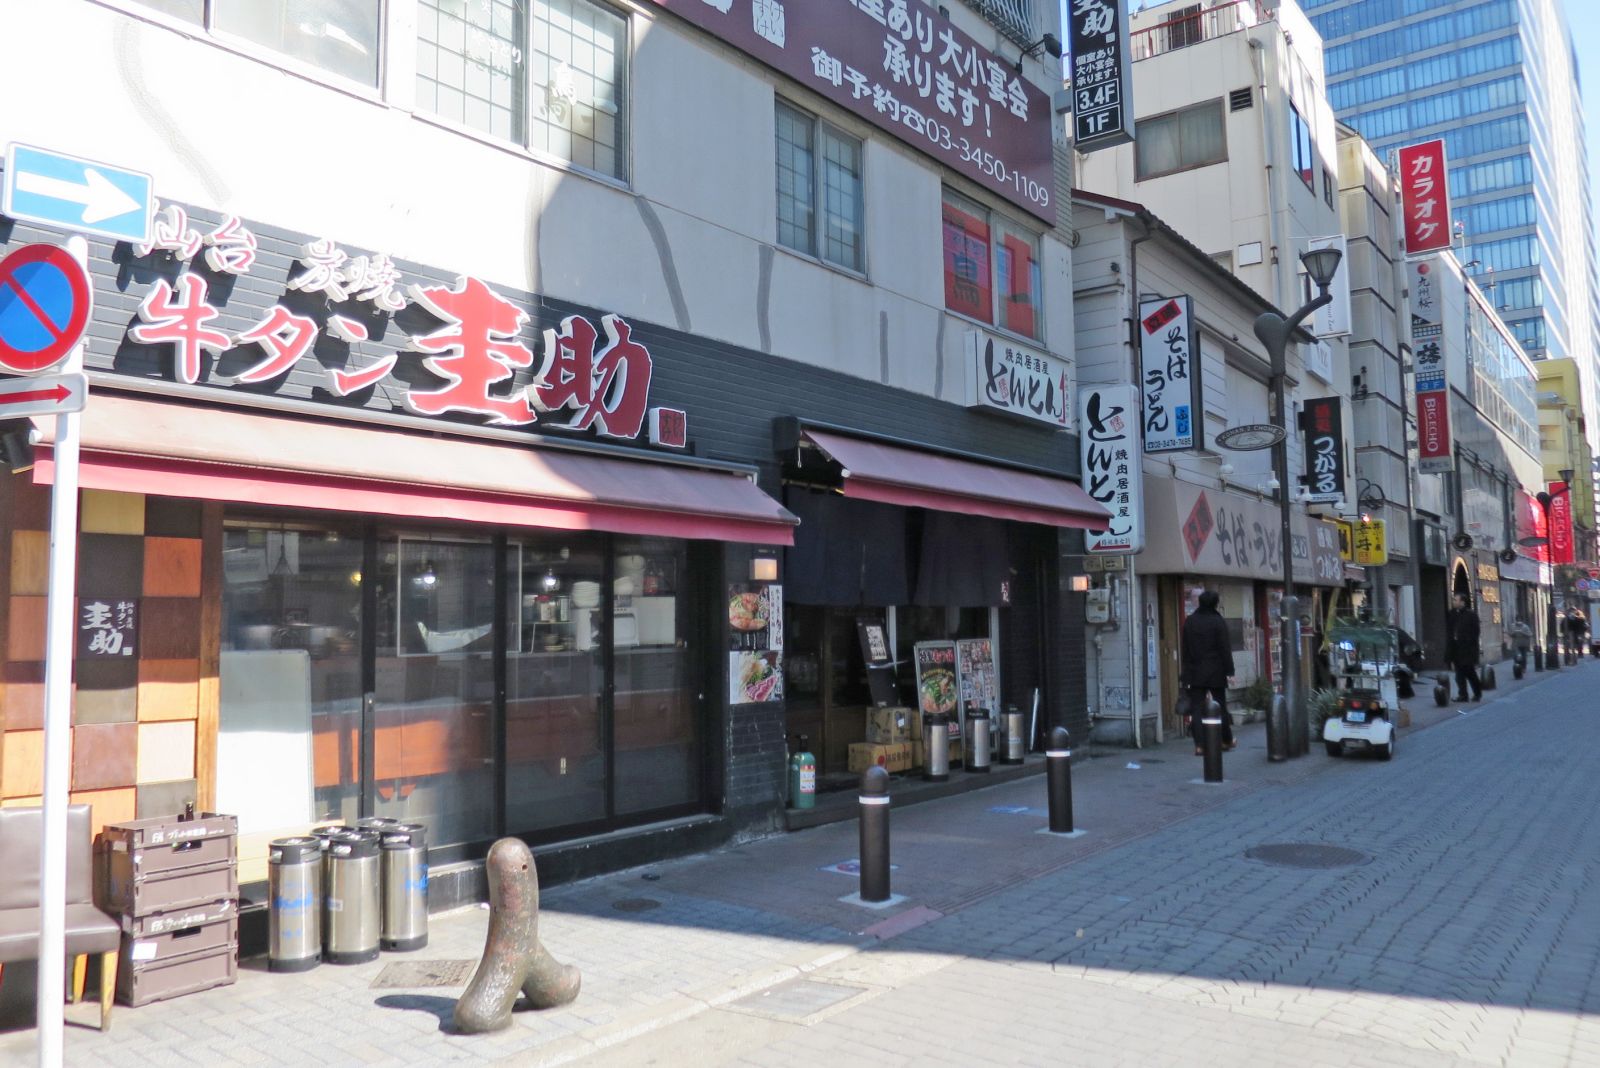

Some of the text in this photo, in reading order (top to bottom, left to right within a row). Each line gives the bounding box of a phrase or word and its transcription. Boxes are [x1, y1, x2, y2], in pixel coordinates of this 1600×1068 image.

[1076, 46, 1115, 67] 個室あり
[1077, 57, 1115, 77] 大小宴会
[1080, 83, 1116, 111] 3.4F
[1087, 112, 1110, 133] 1F
[811, 46, 1049, 207] 御予約 03-3450-1109
[1411, 156, 1439, 242] カラオケ
[138, 200, 258, 274] 仙台
[985, 337, 1063, 418] とんとん
[1005, 347, 1049, 375] 焼肉居酒屋
[1164, 326, 1187, 381] そば
[1145, 369, 1169, 433] うどん
[1115, 449, 1130, 517] 焼肉居酒屋
[1313, 436, 1337, 493] つがる
[1316, 552, 1341, 581] つがる
